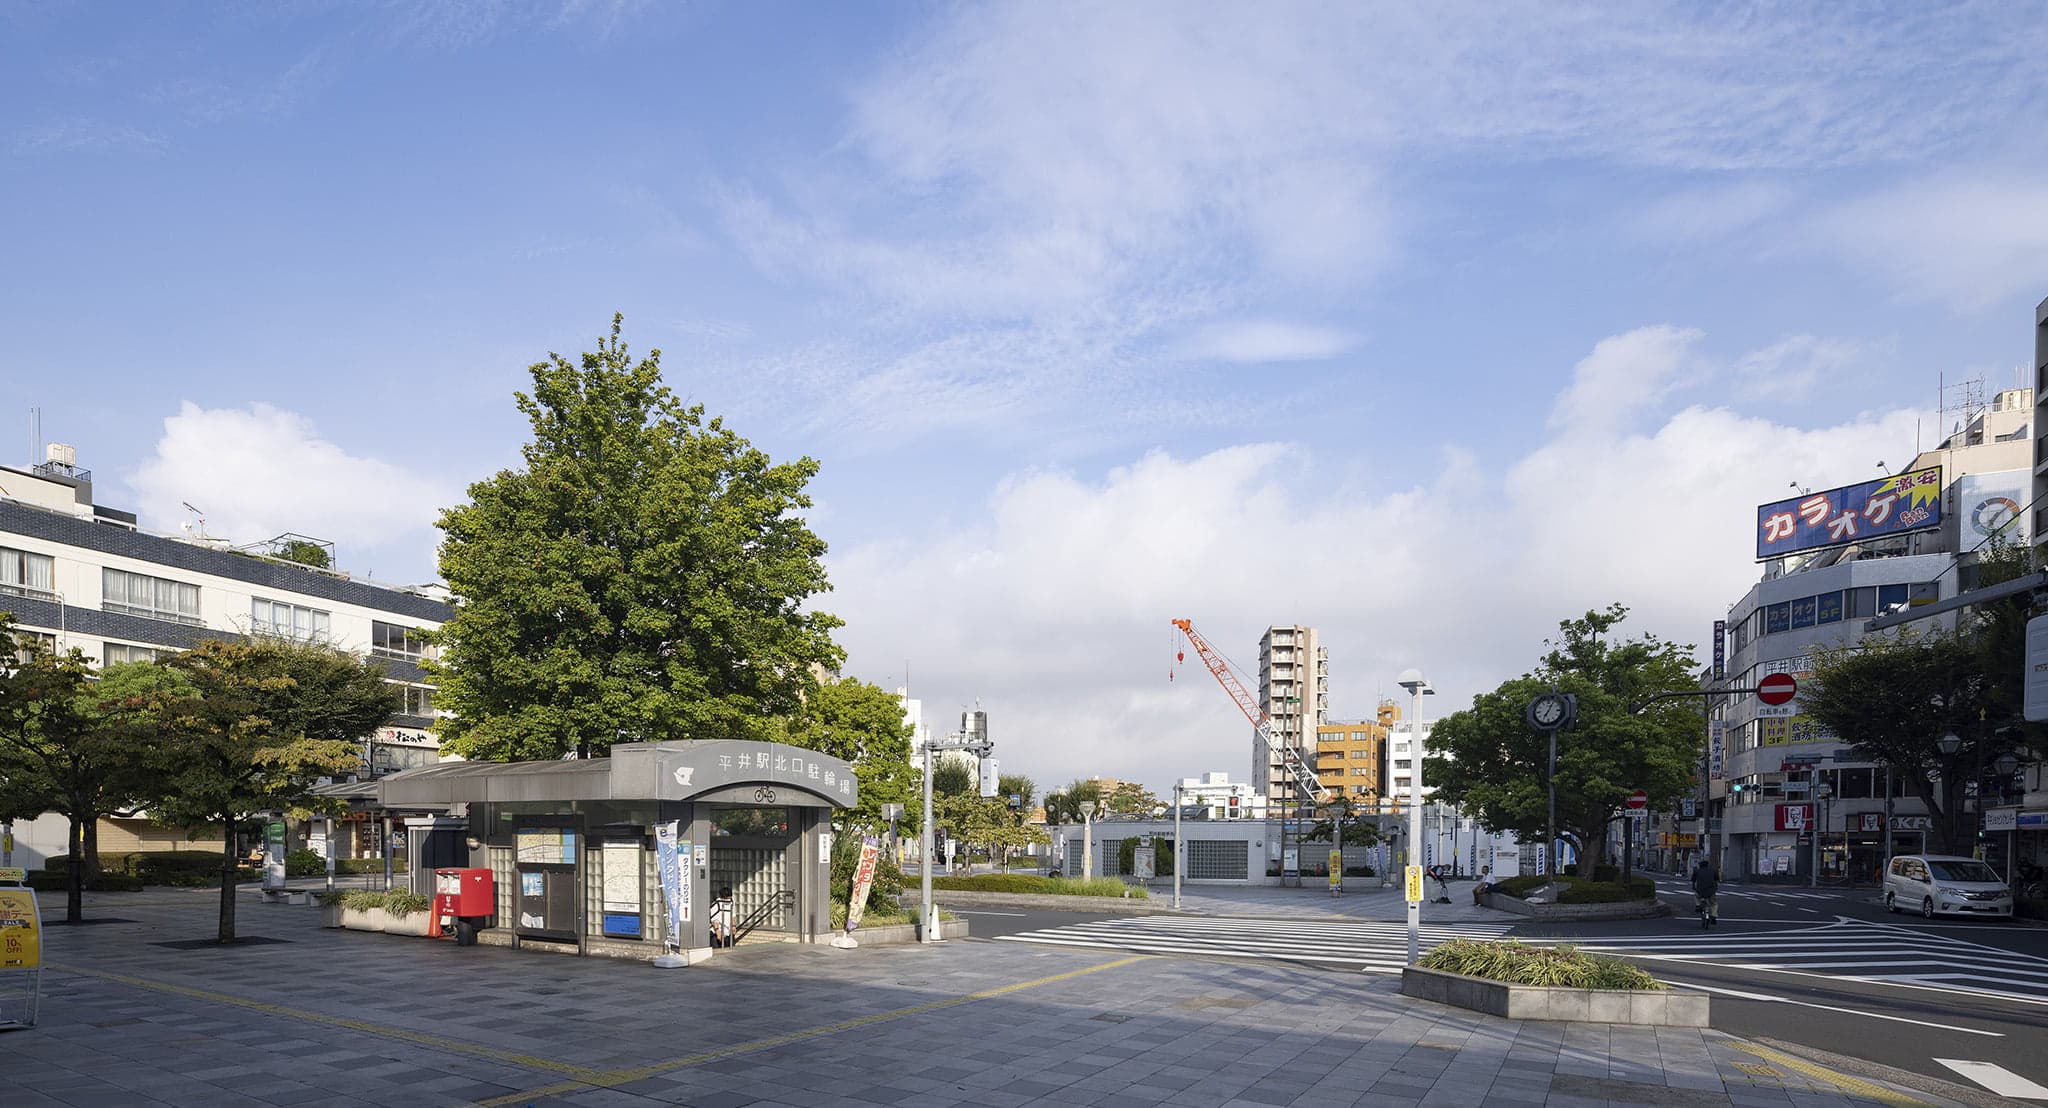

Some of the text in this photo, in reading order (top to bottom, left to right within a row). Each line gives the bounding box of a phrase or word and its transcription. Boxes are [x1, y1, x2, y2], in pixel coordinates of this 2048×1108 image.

[1765, 494, 1898, 542] カラオケ
[396, 731, 427, 743] 松のや
[719, 752, 851, 795] 平井駅北口駐輪場
